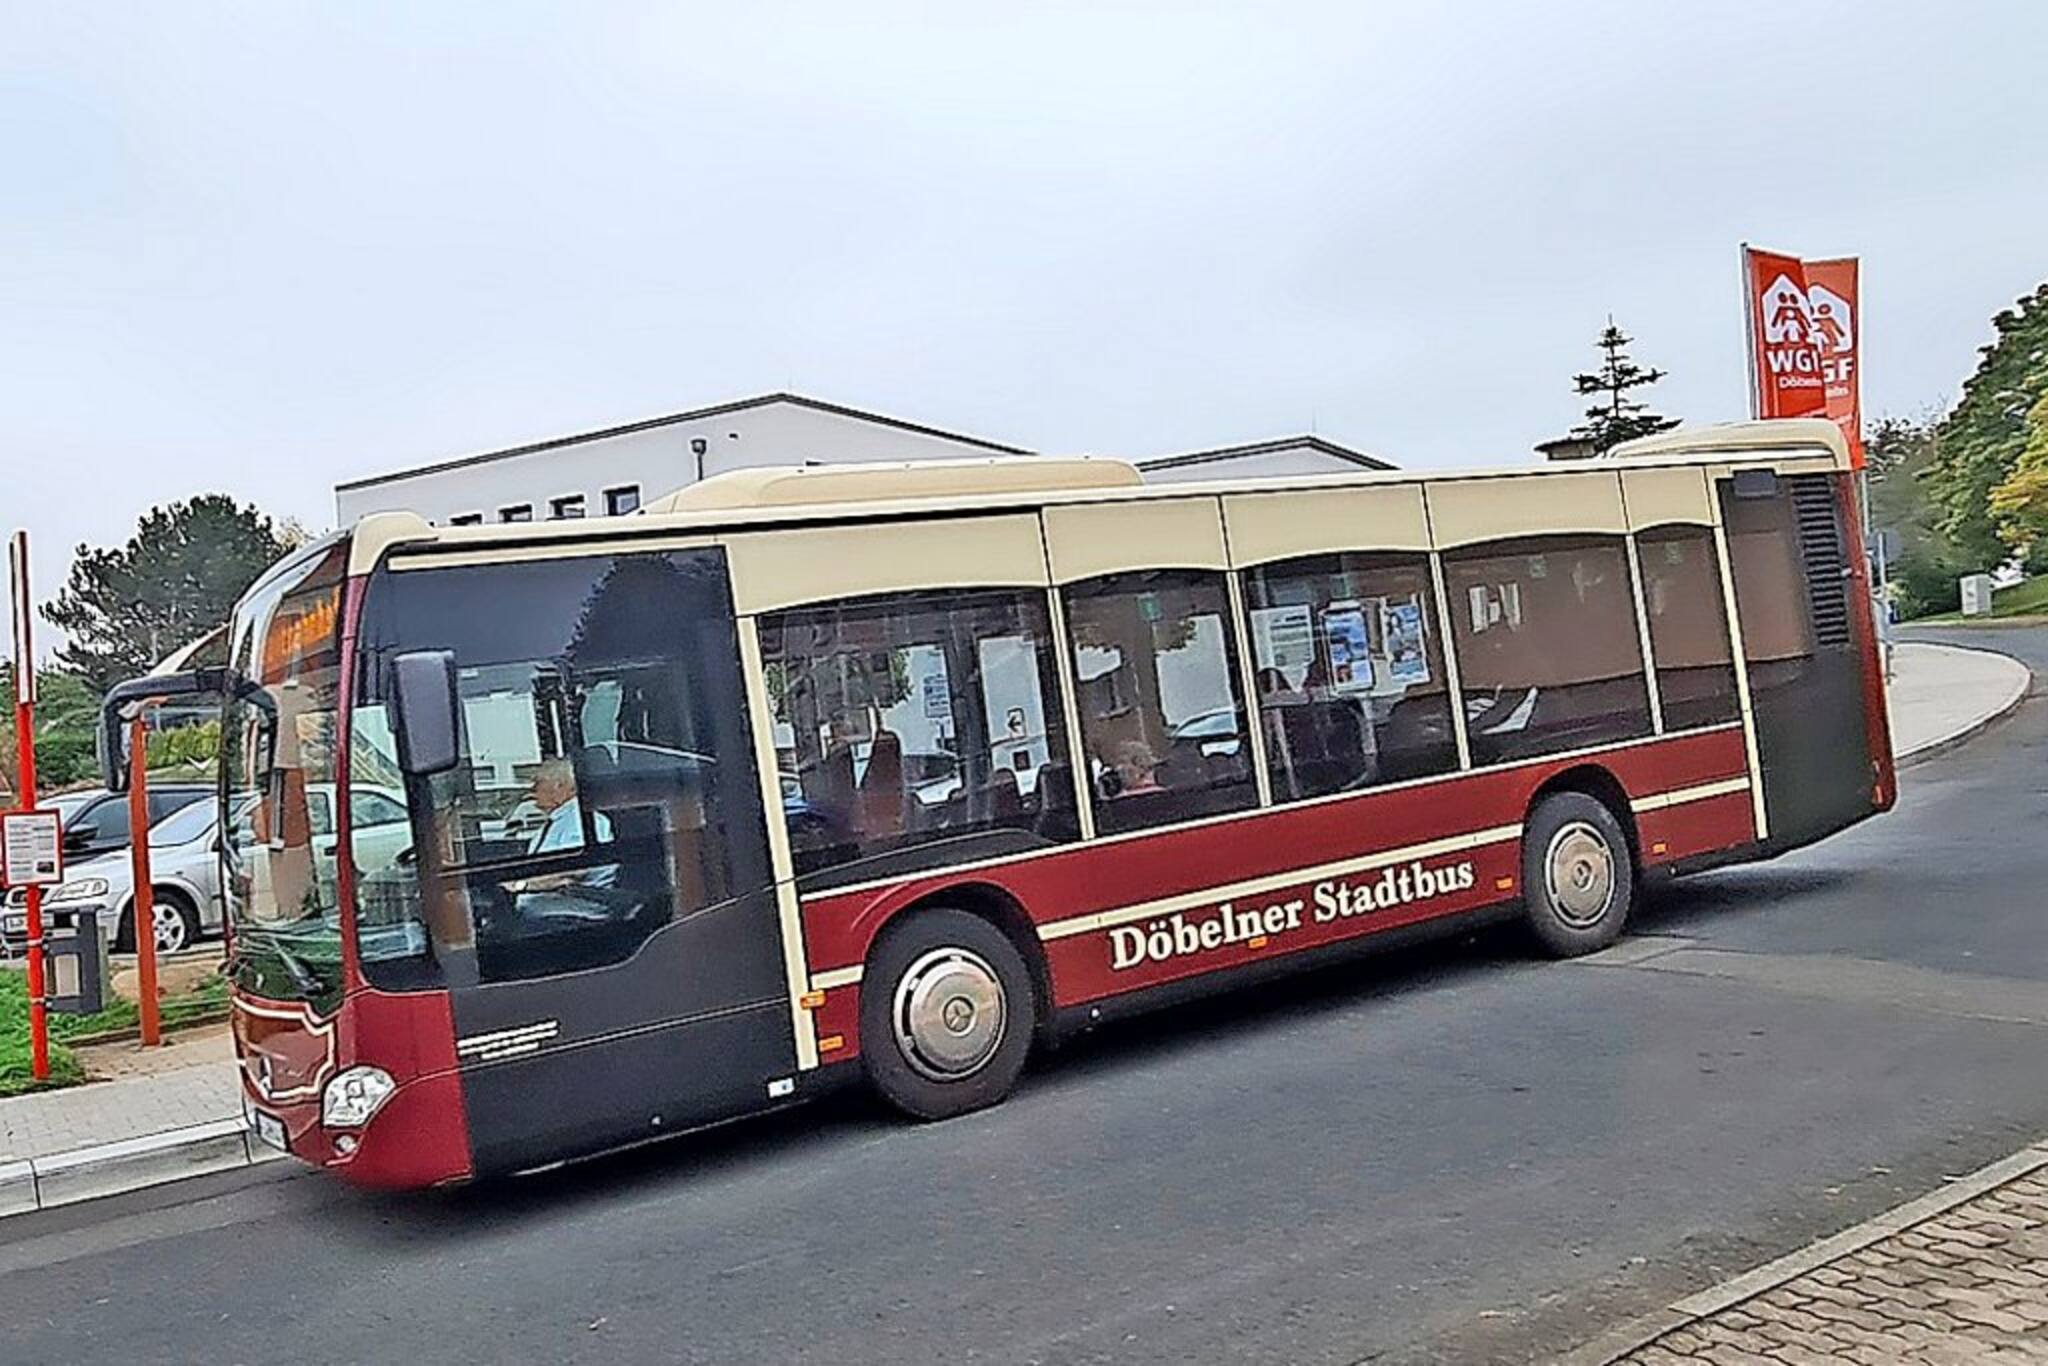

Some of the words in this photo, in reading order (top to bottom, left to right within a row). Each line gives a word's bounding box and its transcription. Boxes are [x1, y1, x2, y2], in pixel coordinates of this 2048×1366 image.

[1821, 358, 1853, 383] GF
[1109, 900, 1304, 969] Döbelner
[1313, 861, 1474, 922] Stadtbus
